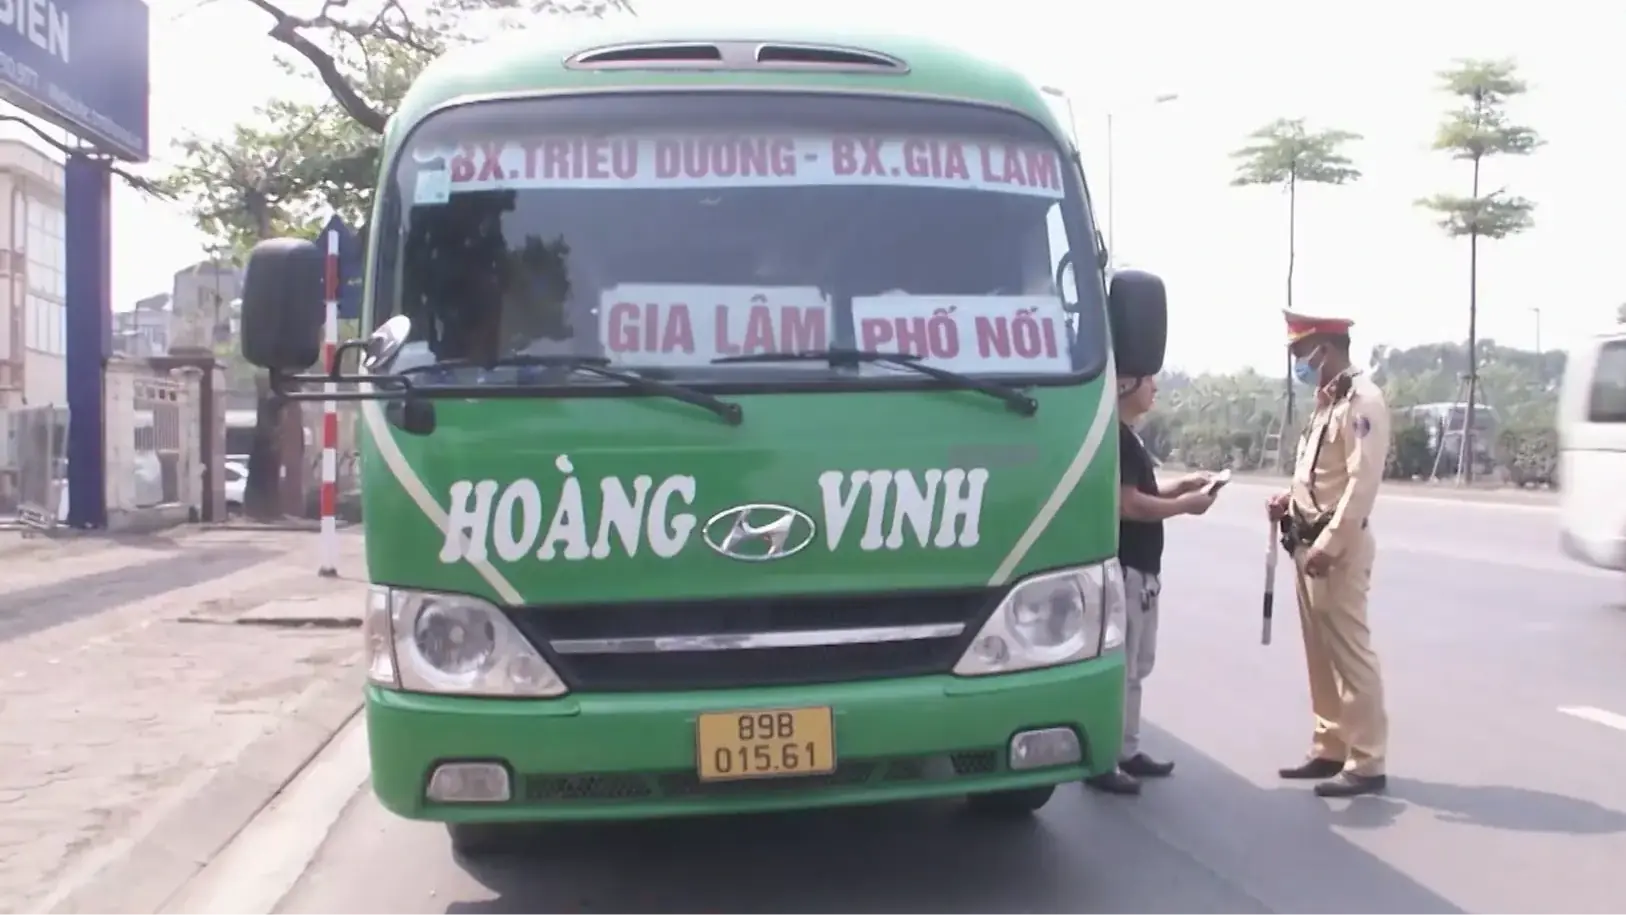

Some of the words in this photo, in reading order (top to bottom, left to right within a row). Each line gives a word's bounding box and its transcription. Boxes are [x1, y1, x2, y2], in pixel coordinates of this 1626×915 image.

[832, 136, 970, 180] BX.GIA
[608, 302, 695, 354] GIA
[714, 293, 826, 356] LÂM
[861, 305, 959, 360] PHỐ
[974, 306, 1059, 359] NỐI
[439, 454, 697, 563] HOÀNG
[818, 468, 989, 551] VINH
[738, 712, 794, 740] 89B
[715, 741, 815, 773] 015.61
